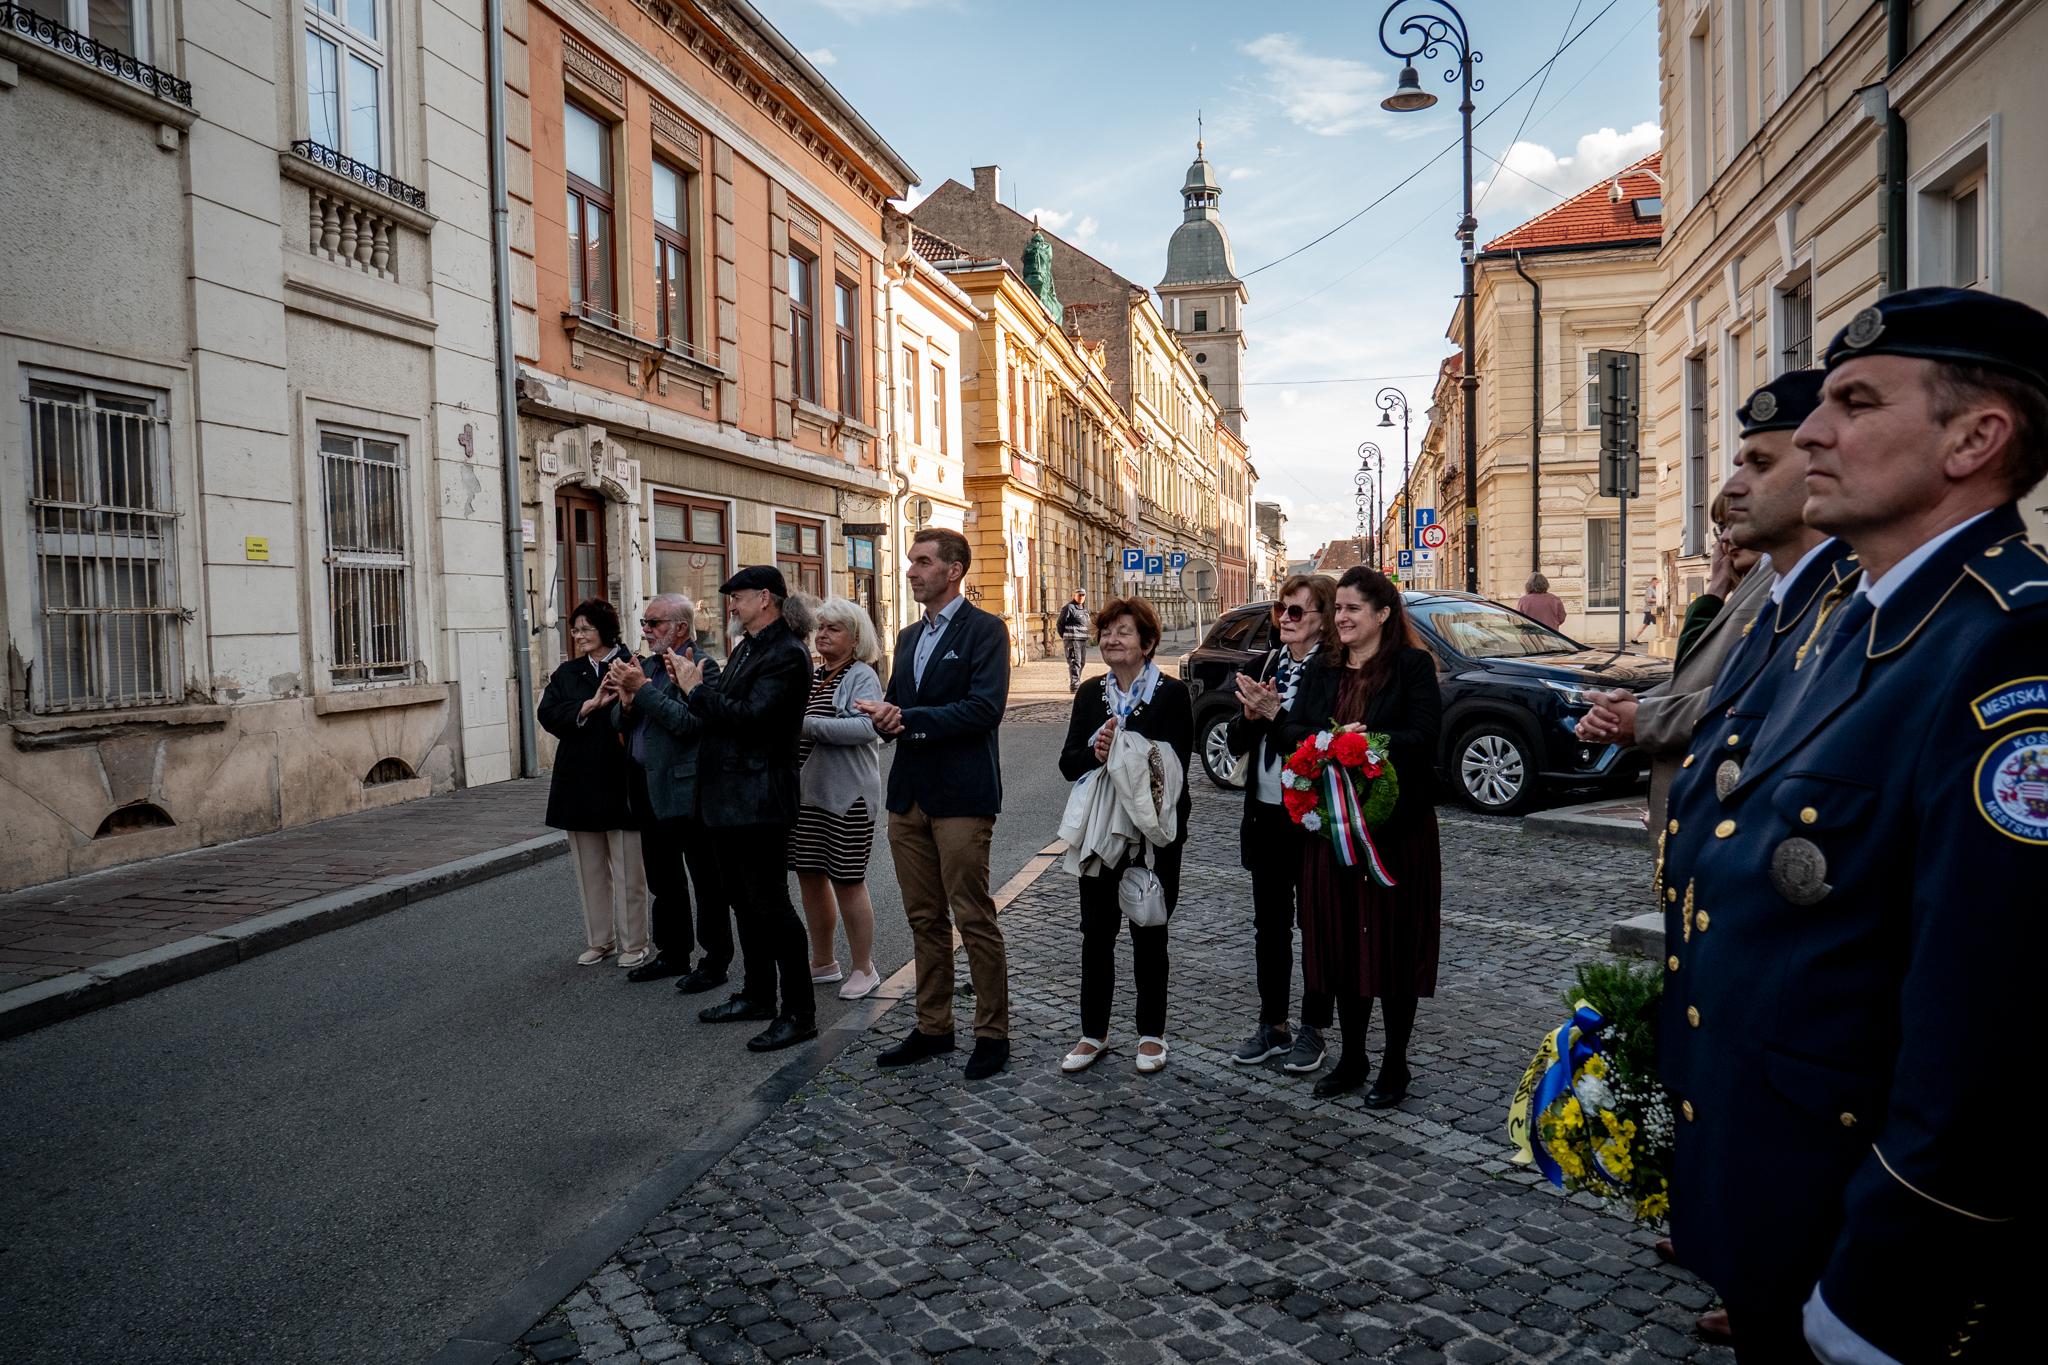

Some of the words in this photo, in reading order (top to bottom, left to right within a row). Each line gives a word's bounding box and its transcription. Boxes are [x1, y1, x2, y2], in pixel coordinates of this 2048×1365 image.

[846, 525, 882, 534] ANTIK
[1128, 552, 1139, 568] P
[1149, 558, 1159, 573] P
[1174, 555, 1183, 566] P
[1401, 552, 1410, 565] P
[1981, 685, 2046, 718] MESTSKÁ
[1985, 800, 2043, 838] MESTSKÁ
